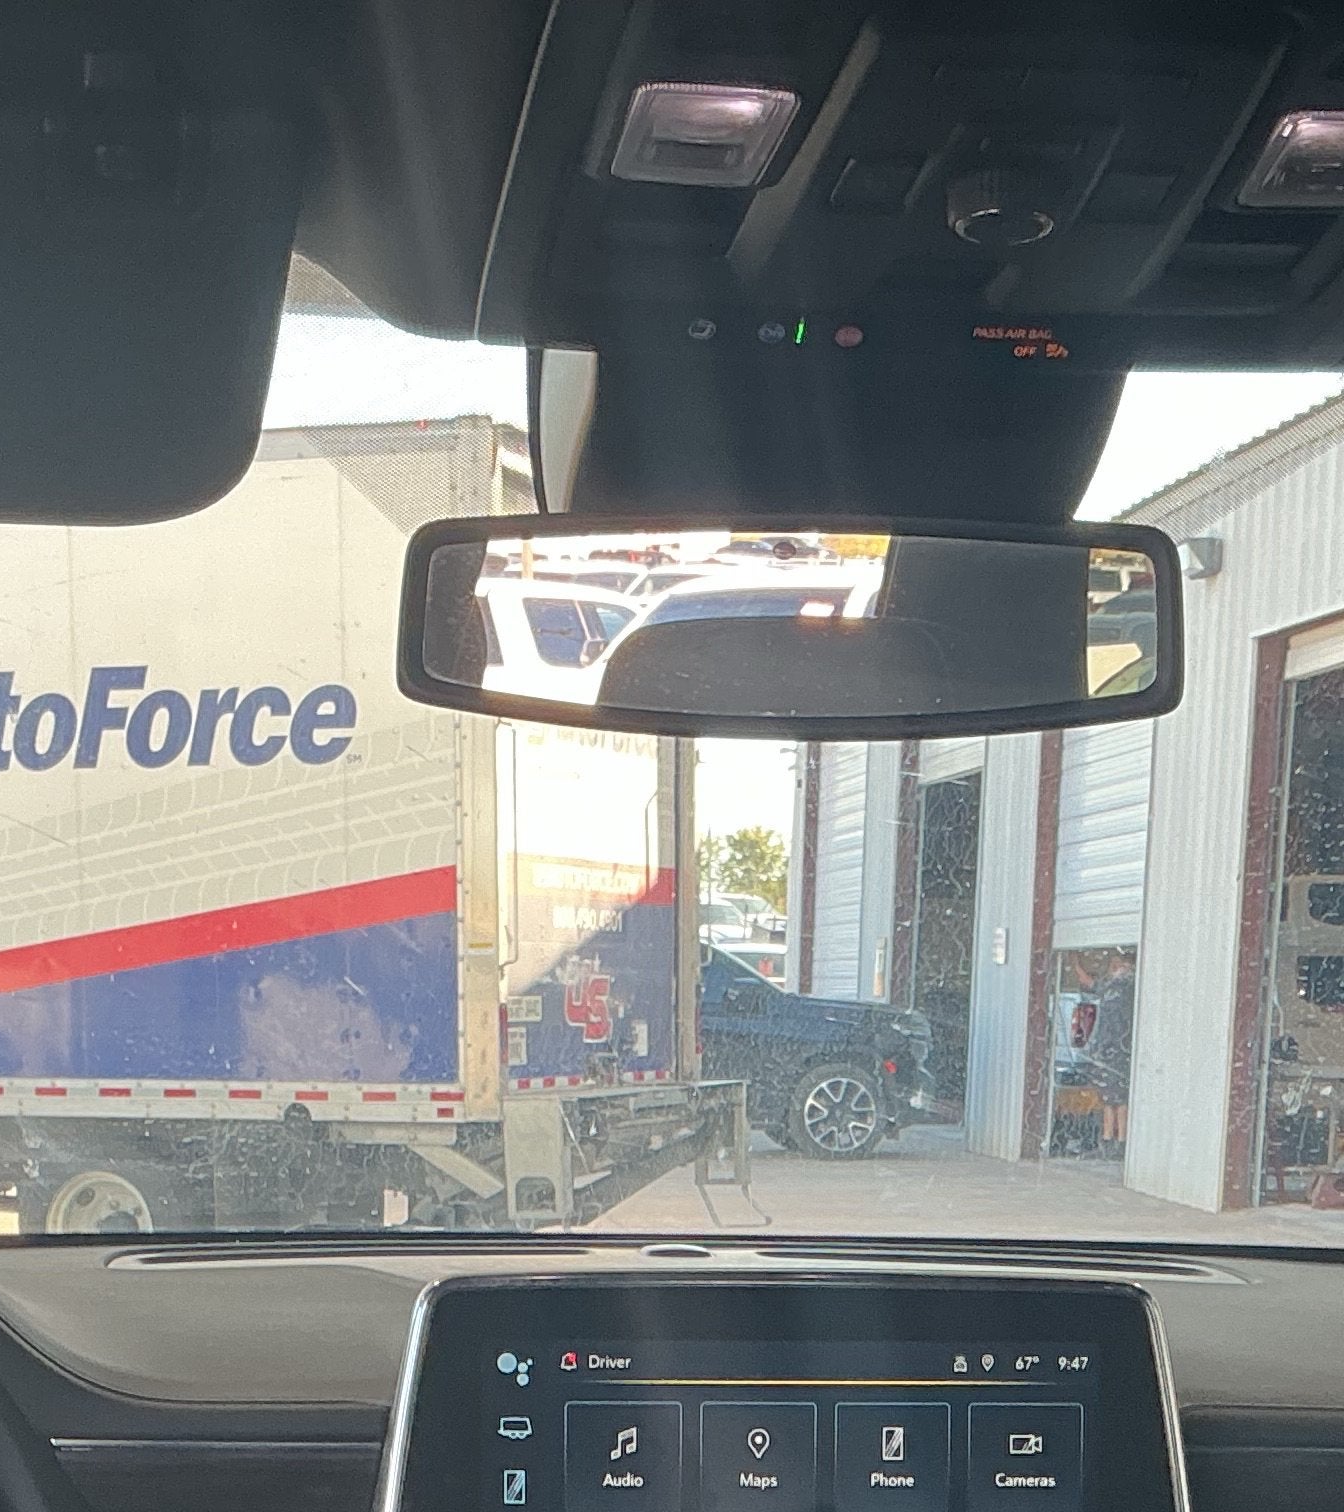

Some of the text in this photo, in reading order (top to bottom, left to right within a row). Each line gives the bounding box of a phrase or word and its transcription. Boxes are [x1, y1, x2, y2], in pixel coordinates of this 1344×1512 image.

[972, 326, 1003, 339] PASS
[1004, 327, 1027, 340] AIR
[1013, 345, 1037, 358] OFF
[588, 1355, 631, 1369] Driver
[1058, 1356, 1089, 1370] 9:47
[602, 1472, 644, 1487] Audio
[739, 1473, 778, 1490] Maps
[870, 1472, 915, 1488] Phone
[995, 1473, 1056, 1488] Cameras
